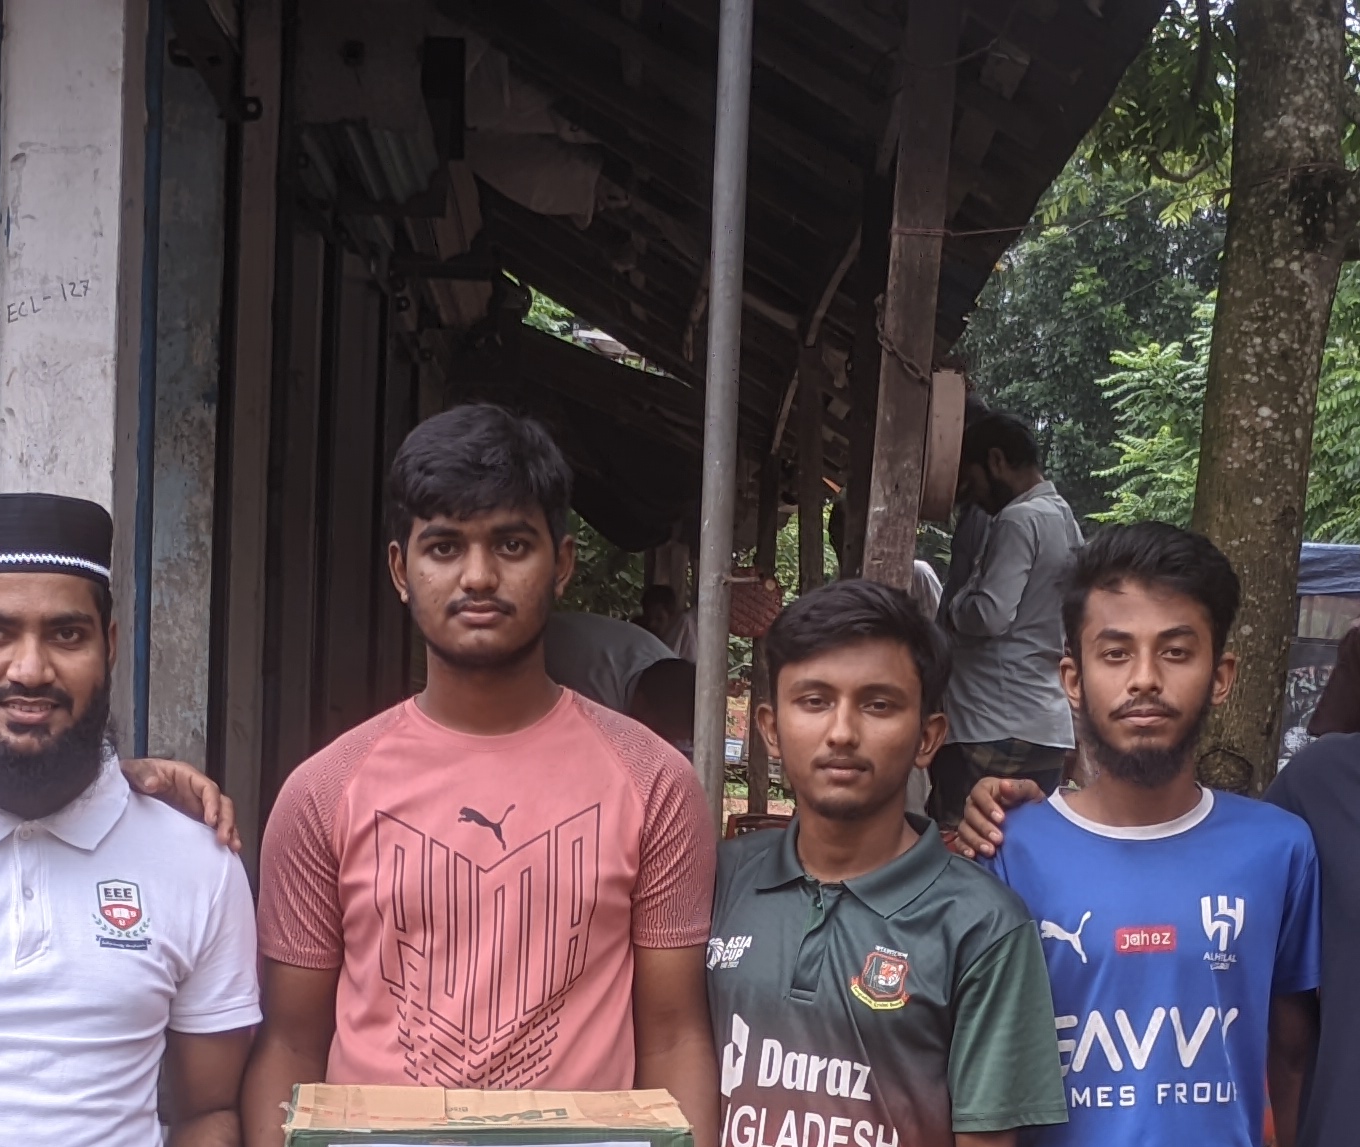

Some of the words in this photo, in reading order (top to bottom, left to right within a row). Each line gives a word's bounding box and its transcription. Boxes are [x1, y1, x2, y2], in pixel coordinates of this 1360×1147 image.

[103, 887, 133, 899] EEE
[725, 935, 753, 950] ASIA
[1120, 930, 1172, 950] jahez
[721, 948, 745, 962] CUP
[757, 1038, 872, 1101] Daraz
[1071, 1084, 1136, 1108] MES
